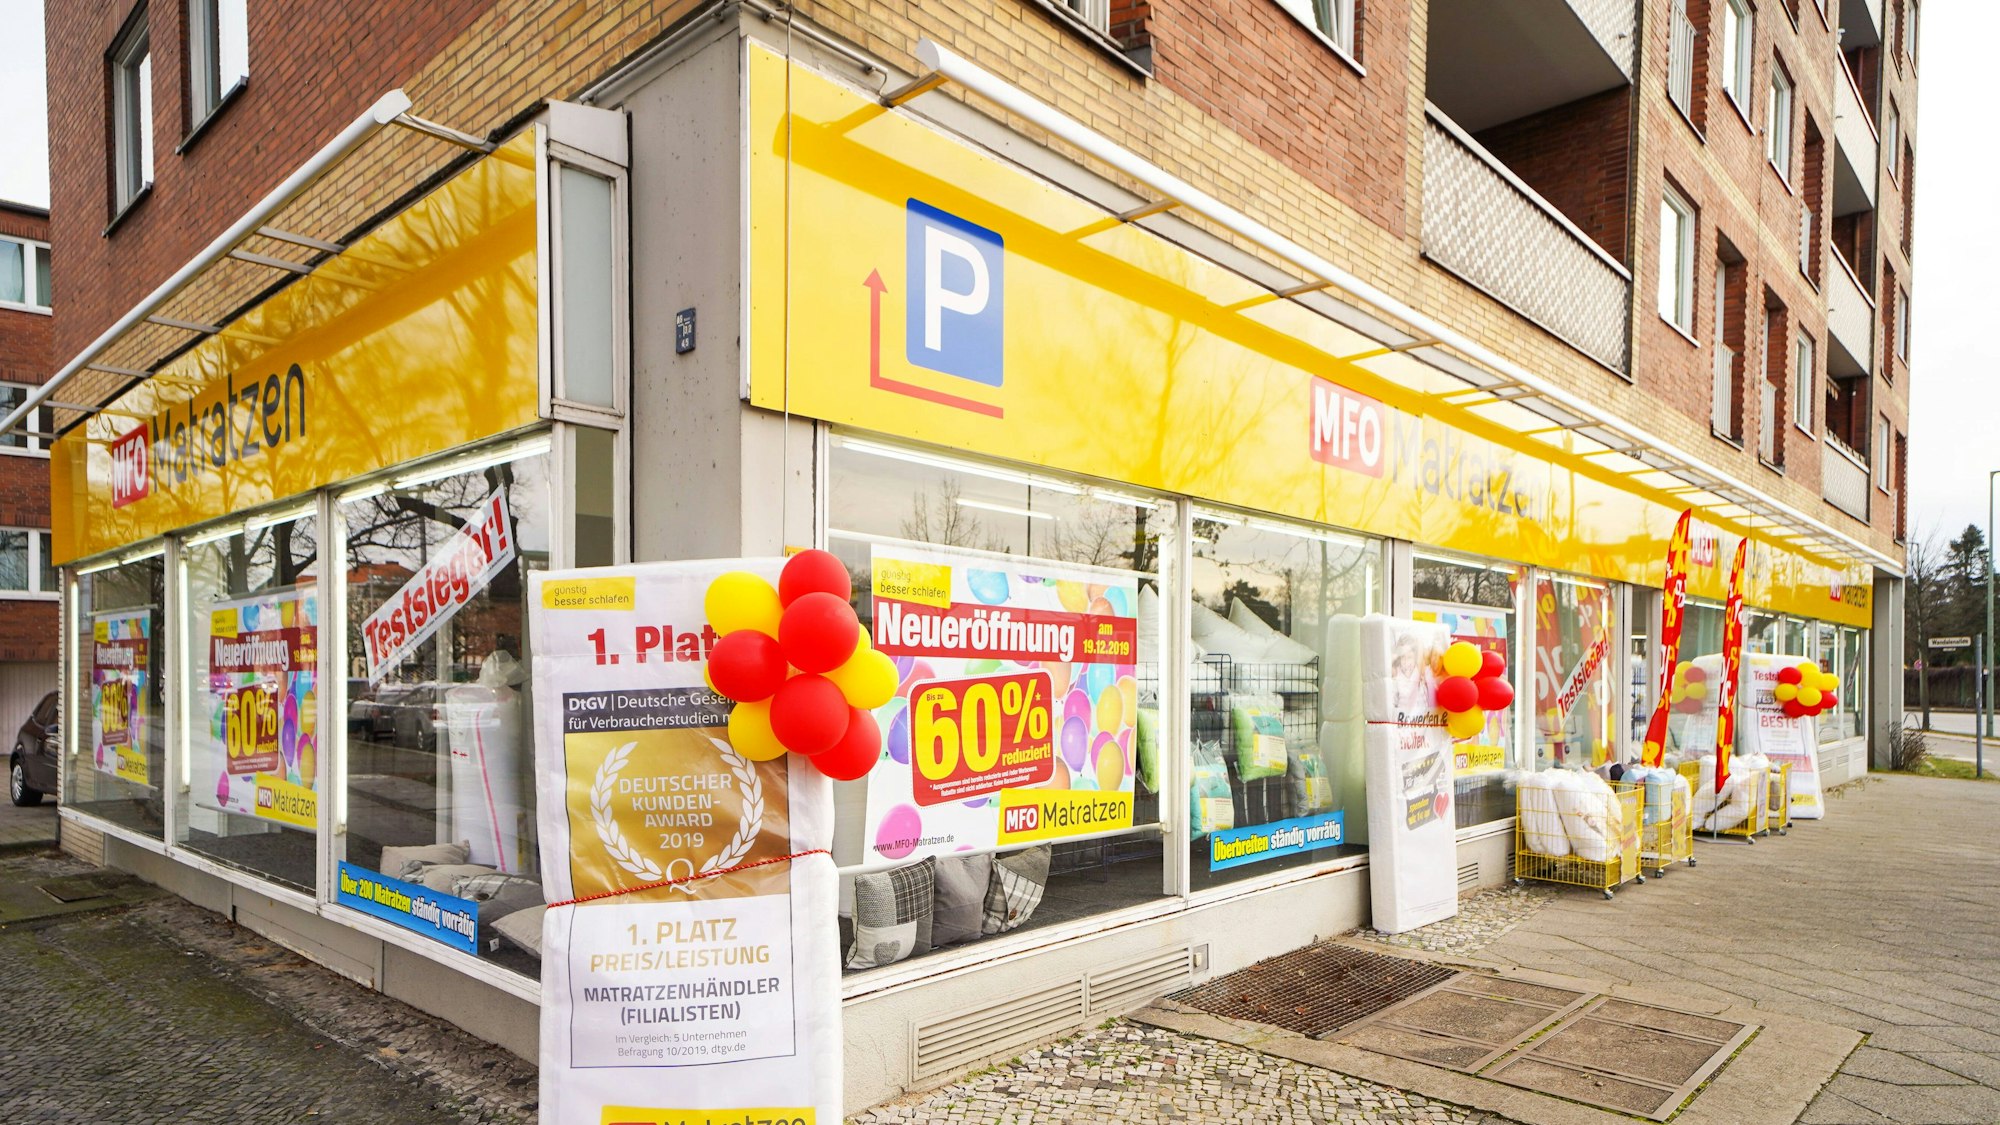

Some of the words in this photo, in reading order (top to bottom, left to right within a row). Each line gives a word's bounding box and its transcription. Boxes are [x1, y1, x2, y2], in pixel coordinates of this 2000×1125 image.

[925, 225, 990, 351] P
[114, 434, 146, 502] MFO
[153, 363, 305, 493] Matratzen
[1314, 385, 1381, 467] MFO
[1393, 407, 1543, 523] Matratzen
[1692, 525, 1713, 563] MFO
[365, 496, 507, 668] Testsieger!
[880, 569, 911, 582] günstig
[554, 586, 587, 597] günstig
[554, 597, 586, 606] besser
[588, 594, 629, 605] schlafen
[880, 582, 910, 596] besser
[912, 585, 947, 600] schlafen
[877, 601, 1075, 663] Neueröffnung
[1098, 623, 1113, 636] am
[214, 635, 290, 671] Neueröffnung
[587, 628, 619, 665] 1.
[635, 624, 720, 664] Plat
[1082, 638, 1130, 657] 19.12.2019
[1557, 630, 1609, 719] Testsieger!
[1754, 671, 1779, 682] Tests
[568, 696, 608, 711] DtGV
[617, 693, 687, 709] Deutsche
[926, 693, 935, 702] Bis
[937, 693, 944, 701] zu
[227, 687, 277, 759] 60%
[568, 717, 588, 730] für
[589, 711, 718, 729] Verbraucherstudien
[1760, 715, 1799, 729] BESTE
[1001, 742, 1051, 766] reduziert!
[1455, 754, 1468, 769] MFO
[1469, 749, 1503, 769] Matratzen
[618, 773, 732, 794] DEUTSCHER
[273, 788, 317, 819] Matratzen
[632, 793, 721, 812] KUNDEN-
[644, 812, 713, 828] AWARD
[1005, 807, 1038, 833] MFO
[1043, 798, 1126, 829] Matratzen
[659, 832, 704, 849] 2019
[873, 834, 954, 852] www.MFO-Matratzen.de
[1214, 834, 1269, 862] Überbreiten
[1270, 825, 1305, 850] ständig
[1306, 820, 1341, 843] vorrätig
[665, 858, 697, 895] Q
[340, 868, 359, 896] Über
[358, 877, 373, 900] 200
[374, 881, 411, 914] Matratzen
[411, 896, 441, 929] ständig
[442, 910, 475, 943] vorrätig
[626, 923, 648, 946] 1.
[656, 918, 737, 945] PLATZ
[590, 944, 770, 973] PREIS/LEISTUNG
[583, 977, 780, 1002] MATRATZENHÄNDLER
[620, 1001, 741, 1026] (FILIALISTEN)
[615, 1035, 627, 1044] Im
[629, 1032, 672, 1045] Vergleich:
[674, 1034, 680, 1042] 5
[682, 1029, 747, 1042] Unternehmen
[617, 1047, 664, 1059] Befragung
[666, 1045, 710, 1057] 10/2019,
[711, 1042, 746, 1056] dtgv.de
